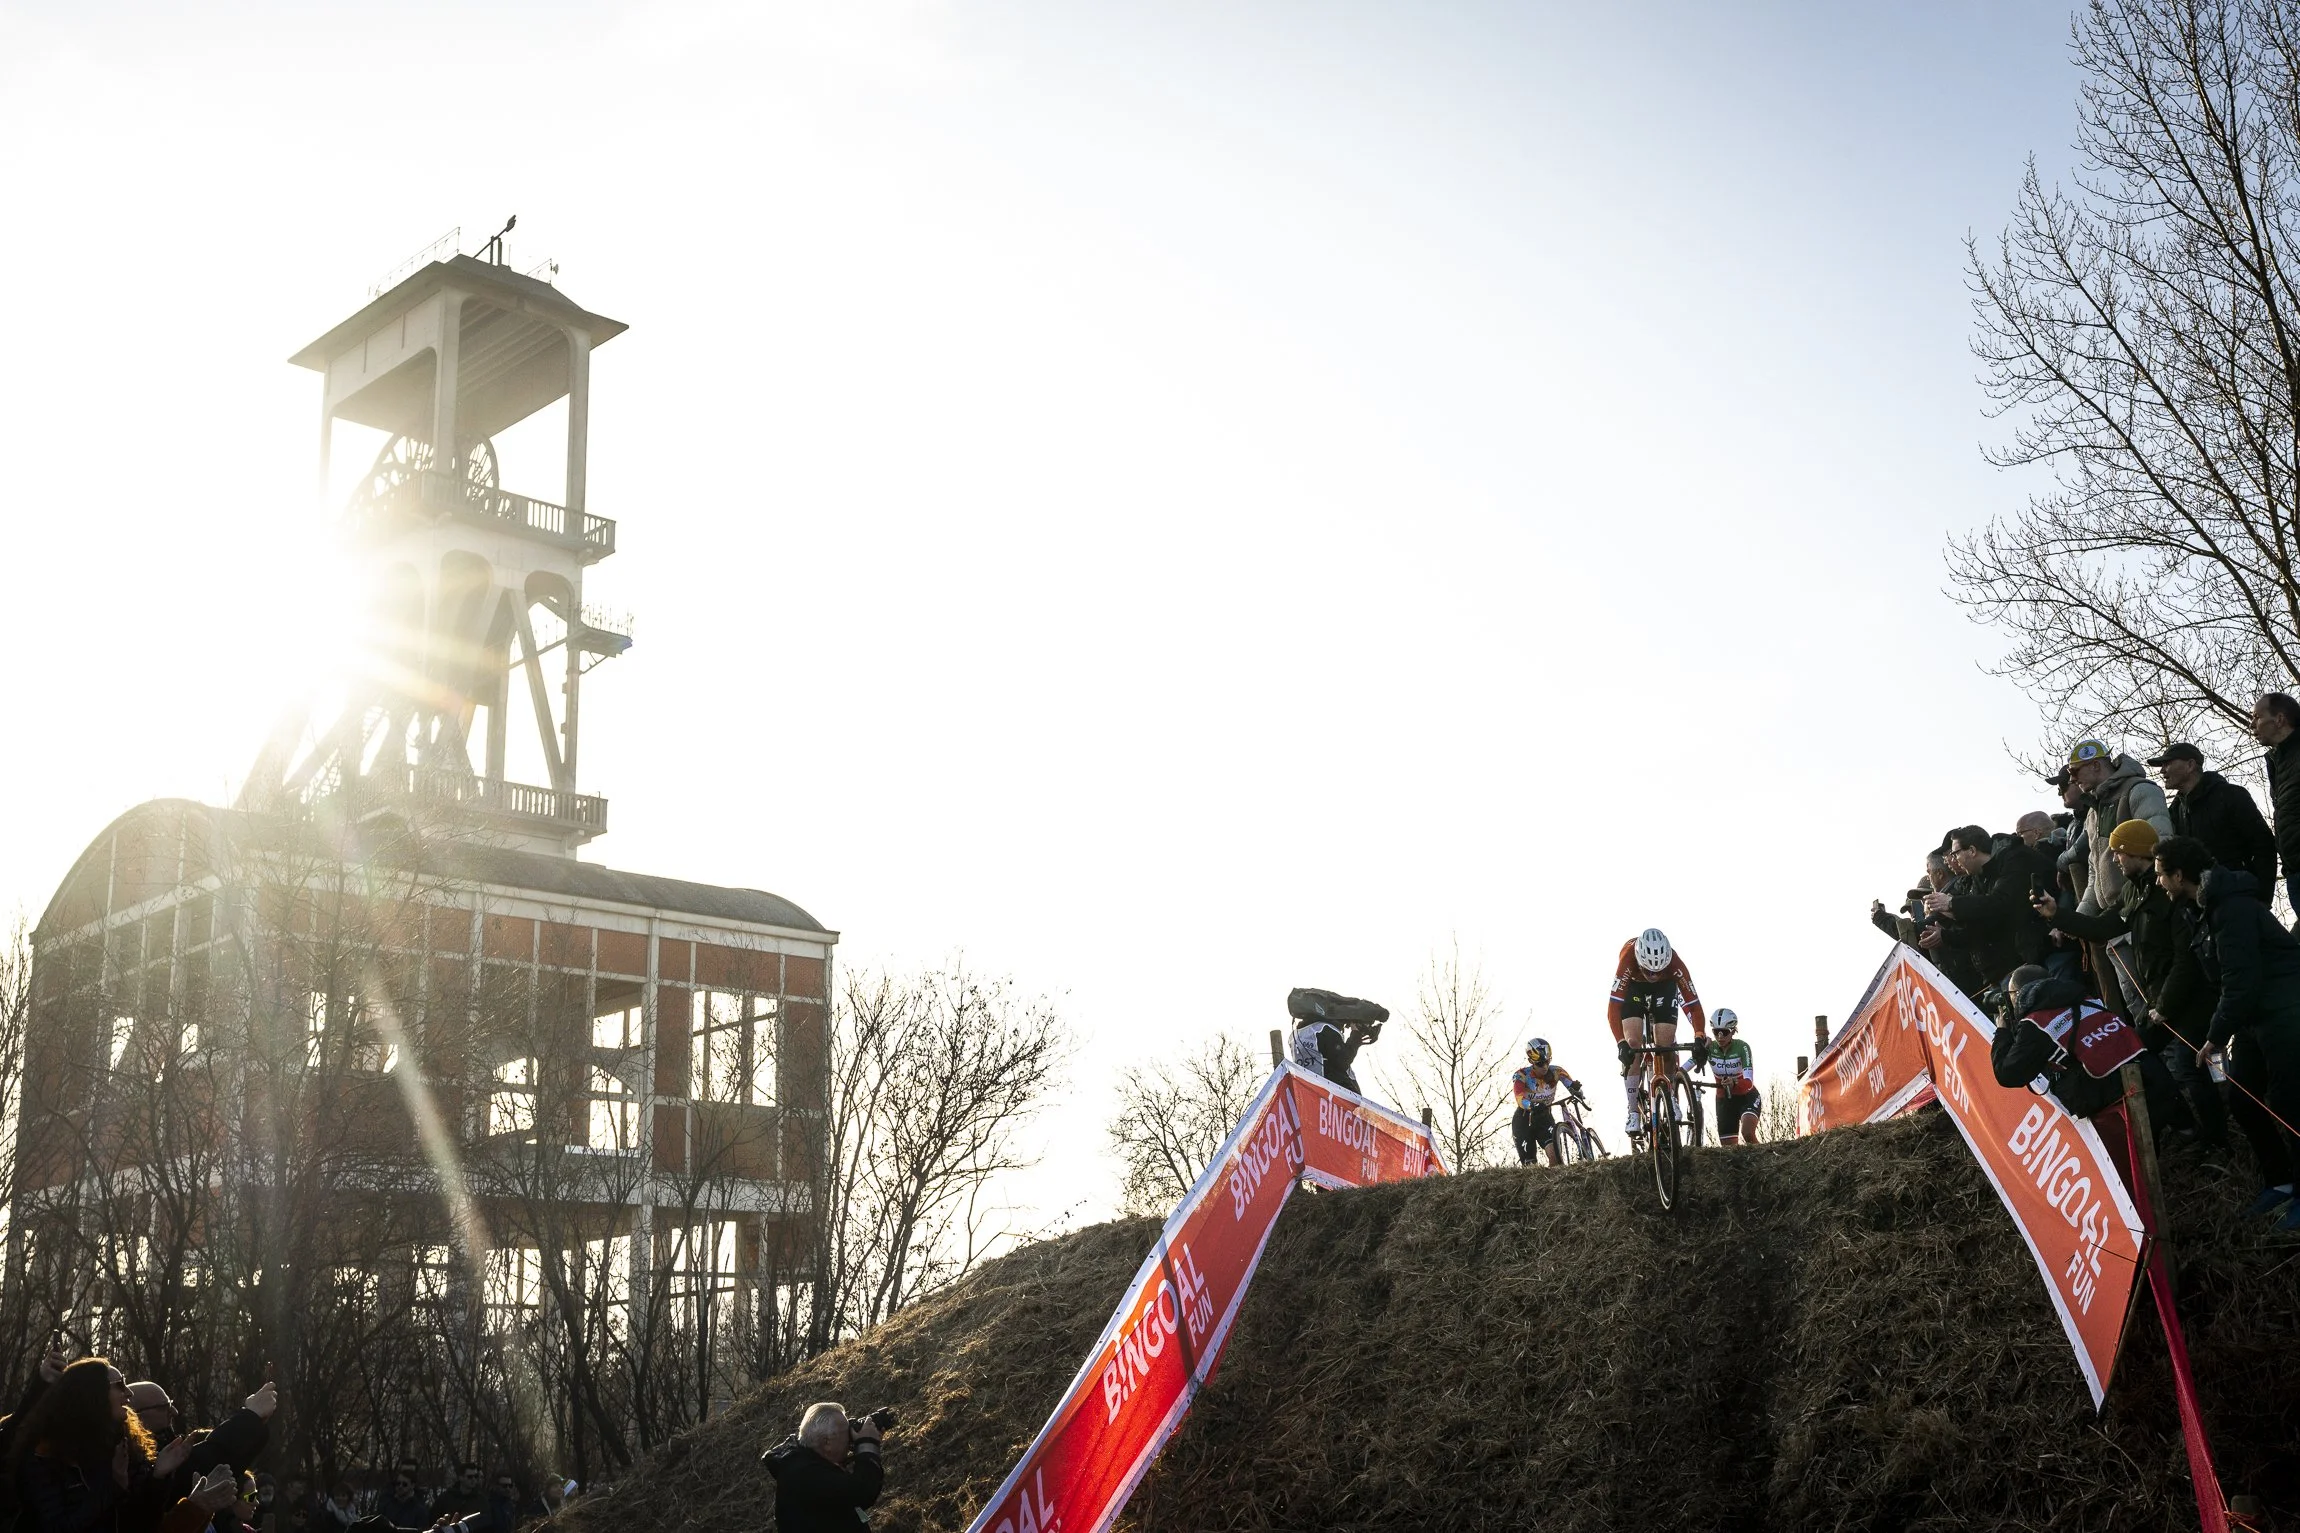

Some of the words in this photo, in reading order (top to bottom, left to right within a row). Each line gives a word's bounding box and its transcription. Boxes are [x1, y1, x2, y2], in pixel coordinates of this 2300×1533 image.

[2081, 1016, 2127, 1048] PHOT
[1867, 1062, 1886, 1098] FUN
[1285, 1134, 1305, 1174] FU
[1361, 1156, 1379, 1183] FUN
[2065, 1249, 2097, 1316] FUN
[1188, 1287, 1215, 1348] FUN
